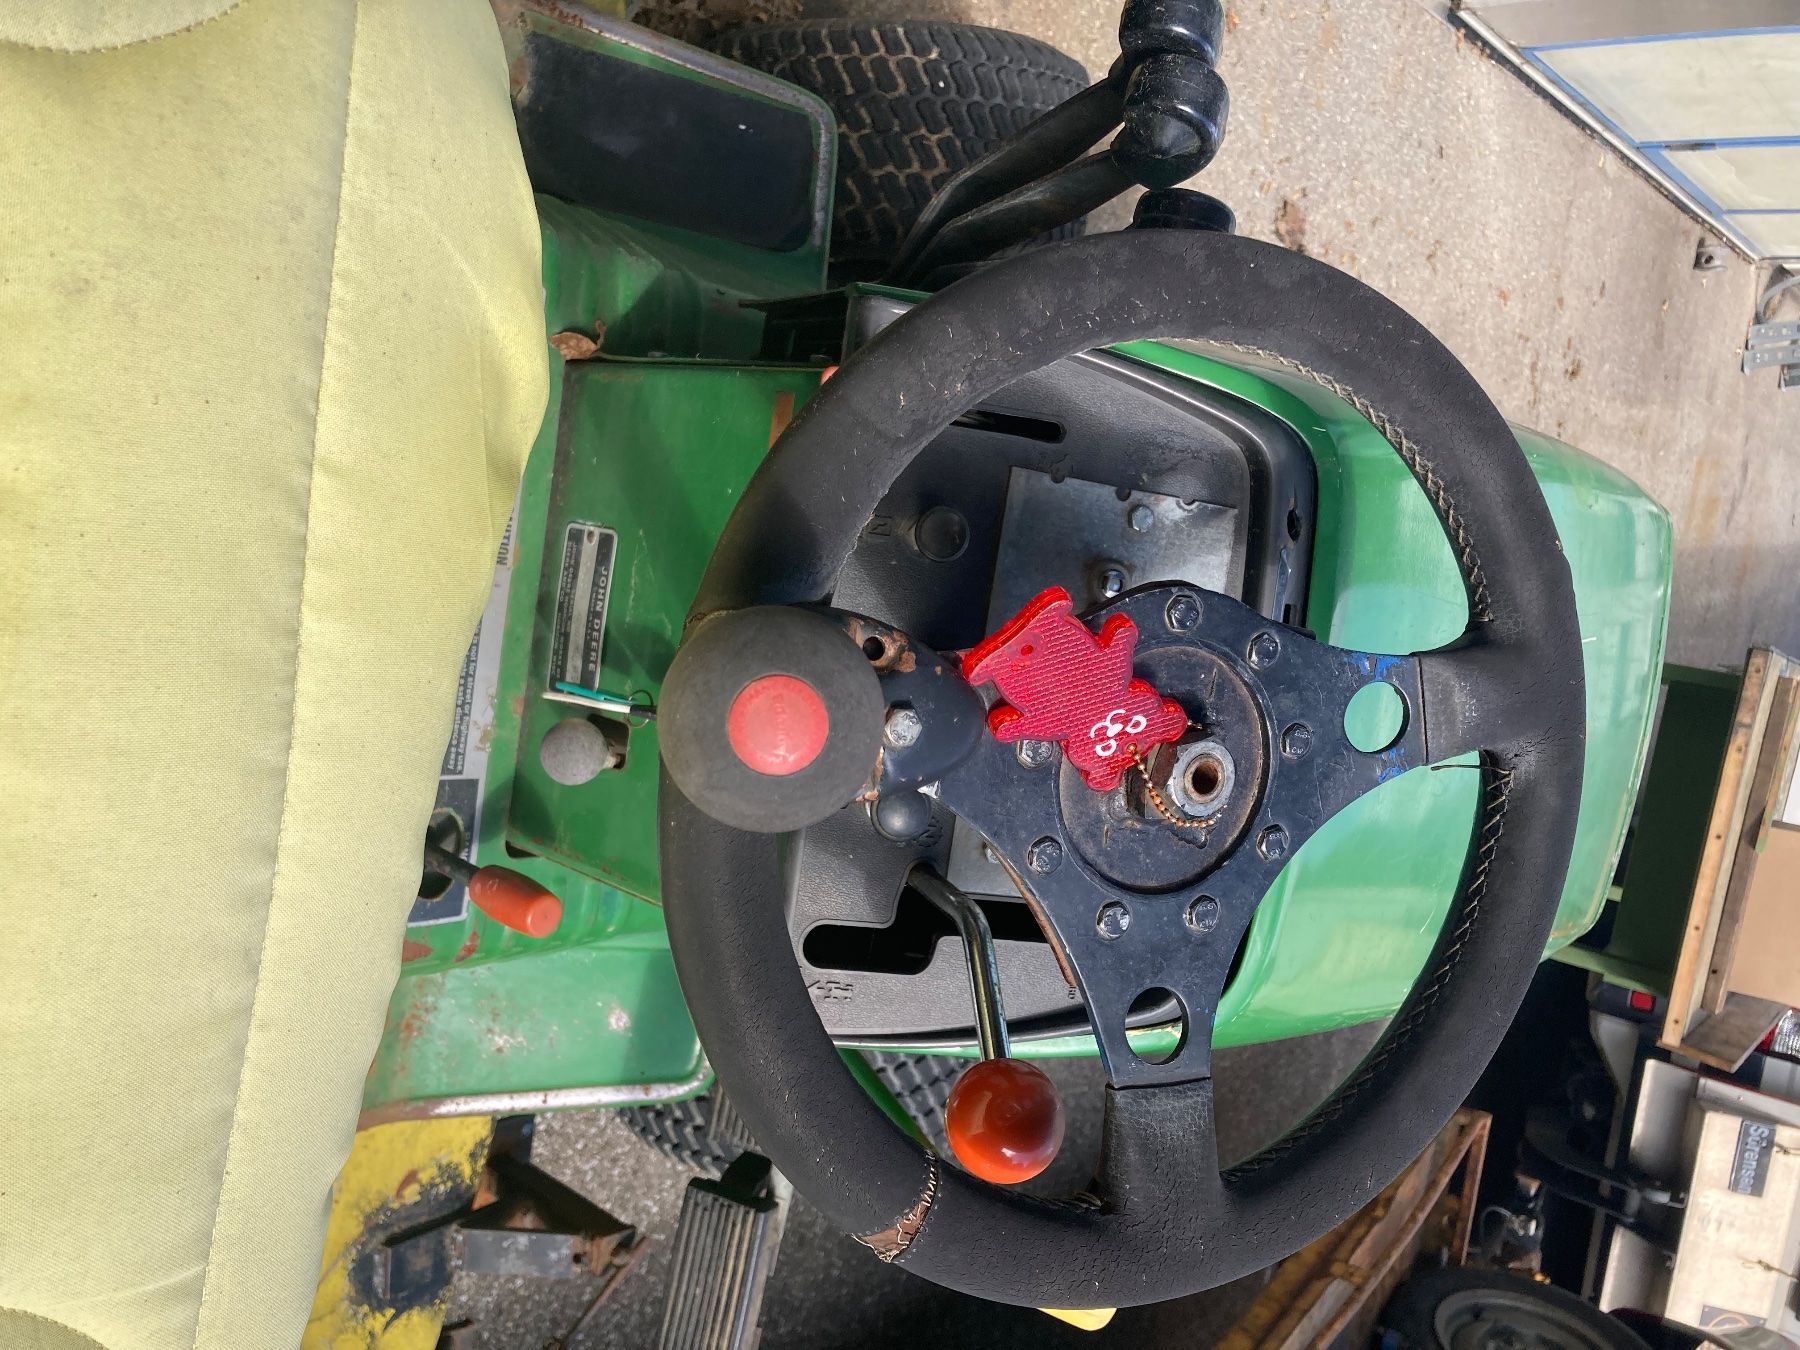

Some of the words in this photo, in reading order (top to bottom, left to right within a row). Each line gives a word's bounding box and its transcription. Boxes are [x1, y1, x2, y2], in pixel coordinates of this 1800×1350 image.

[569, 542, 578, 565] JOHN
[595, 566, 608, 612] JOHN
[470, 646, 478, 661] not
[588, 618, 601, 673] DEERE
[468, 662, 477, 675] for
[456, 686, 465, 706] safe
[464, 677, 475, 703] street
[464, 704, 471, 714] or
[451, 707, 463, 745] distance
[456, 716, 471, 754] highway
[448, 746, 457, 770] away
[456, 755, 465, 774] use.
